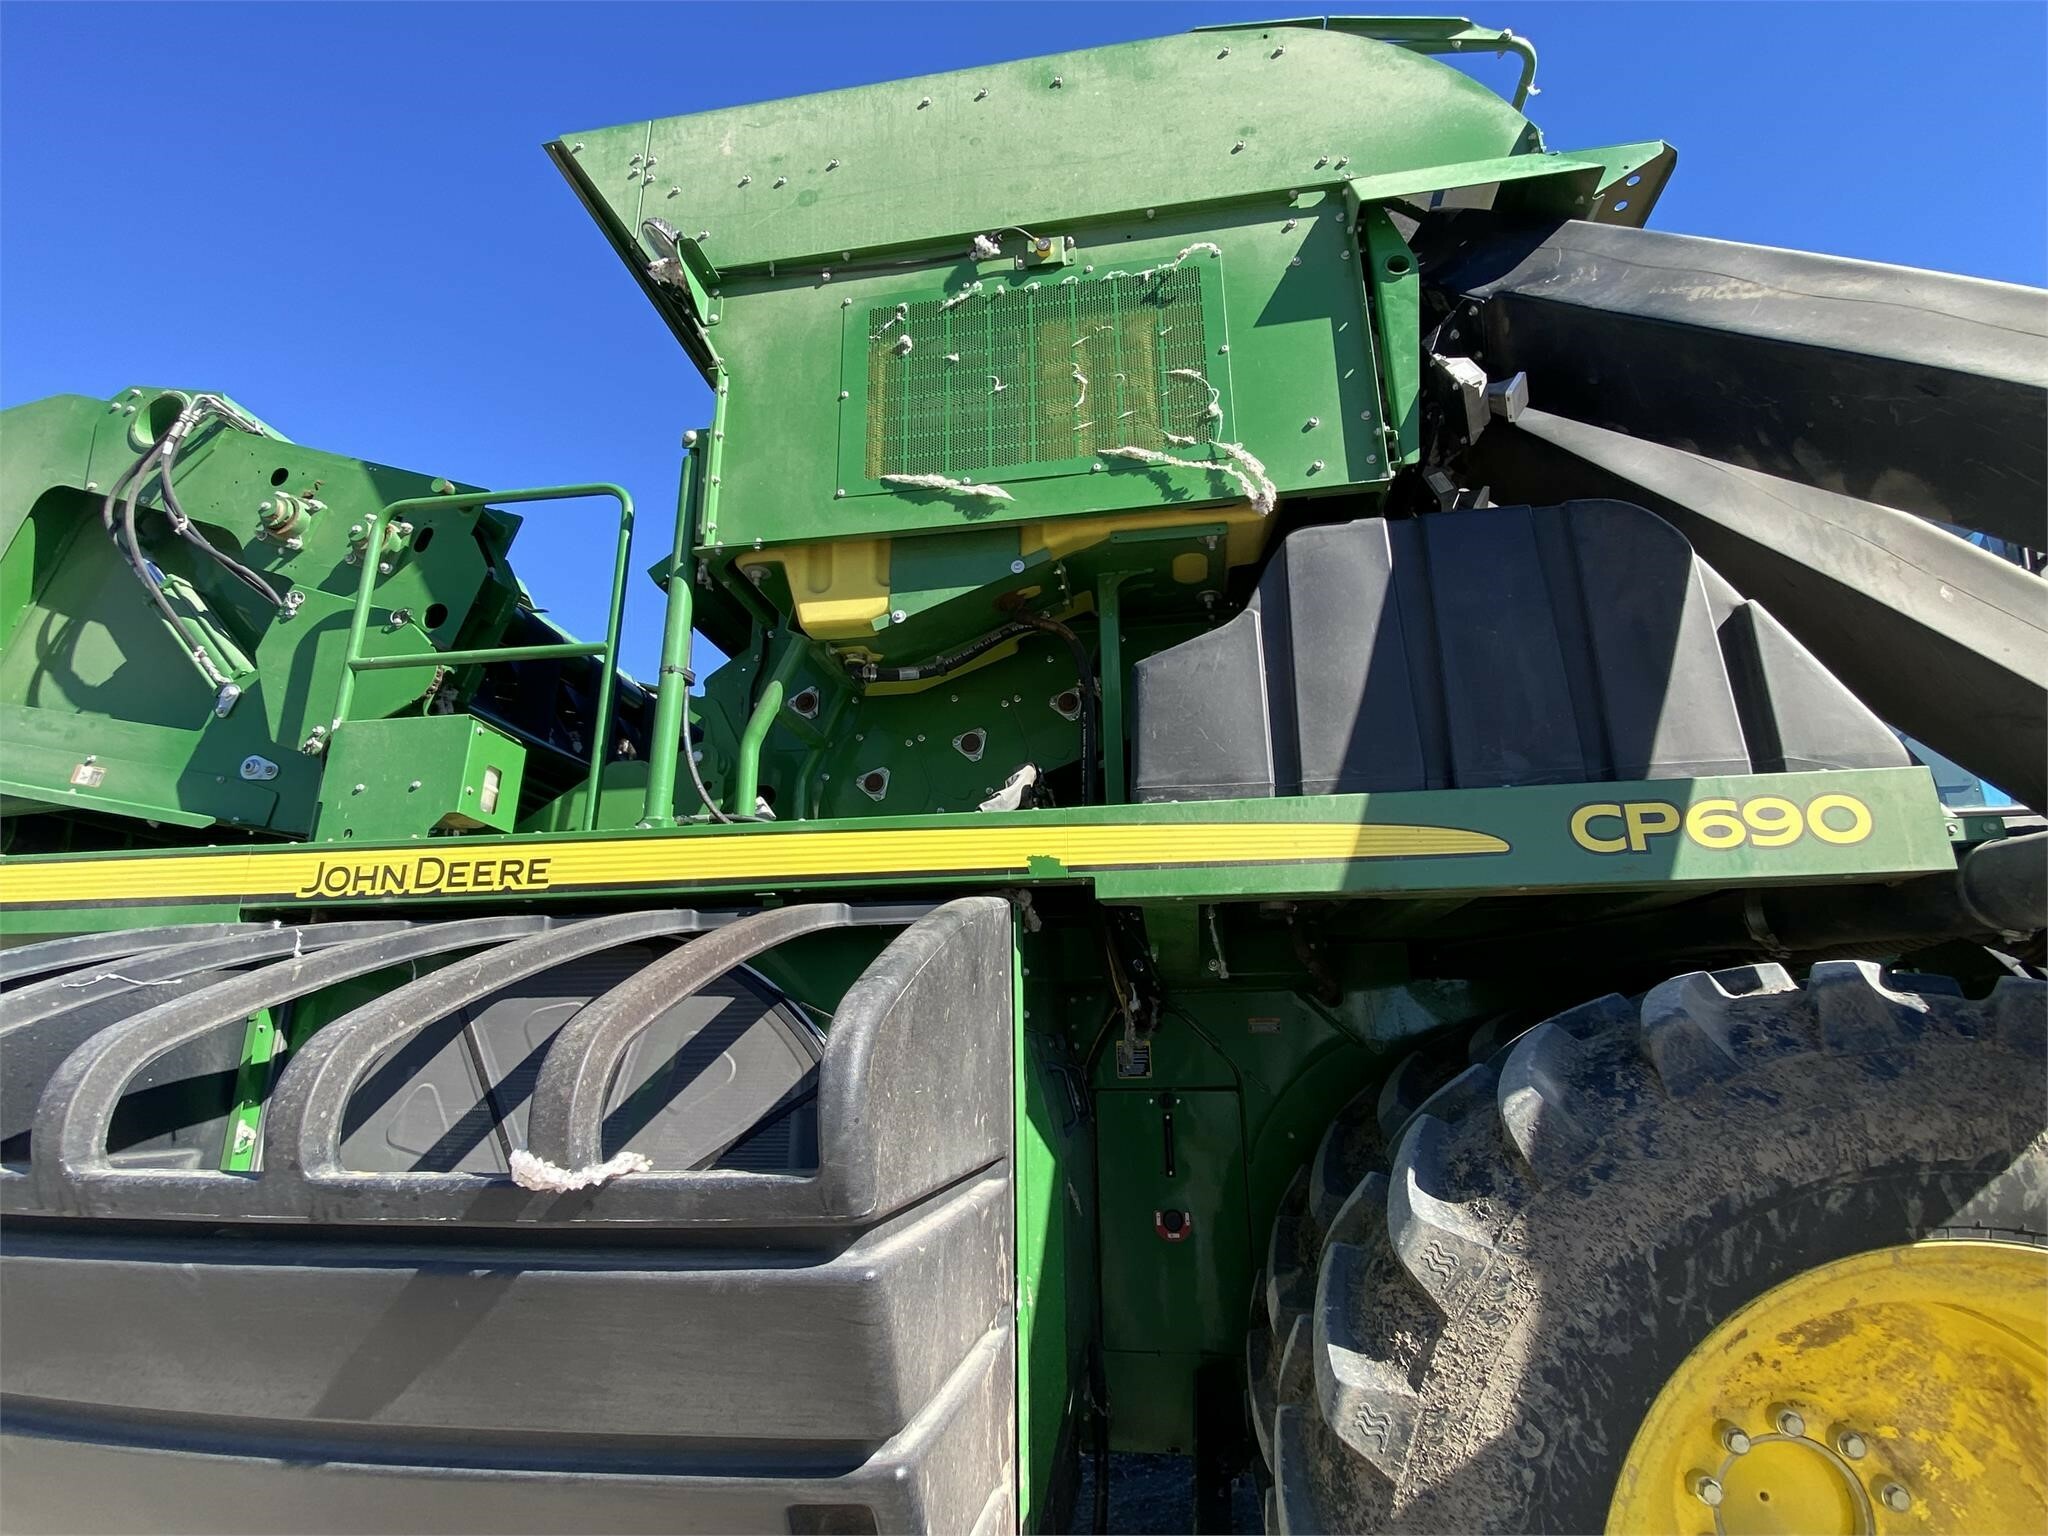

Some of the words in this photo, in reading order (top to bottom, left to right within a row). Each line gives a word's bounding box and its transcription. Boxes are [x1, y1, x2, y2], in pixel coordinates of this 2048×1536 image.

[1569, 792, 1874, 853] CP690
[300, 860, 408, 892] JOHN
[413, 857, 552, 890] DEERE
